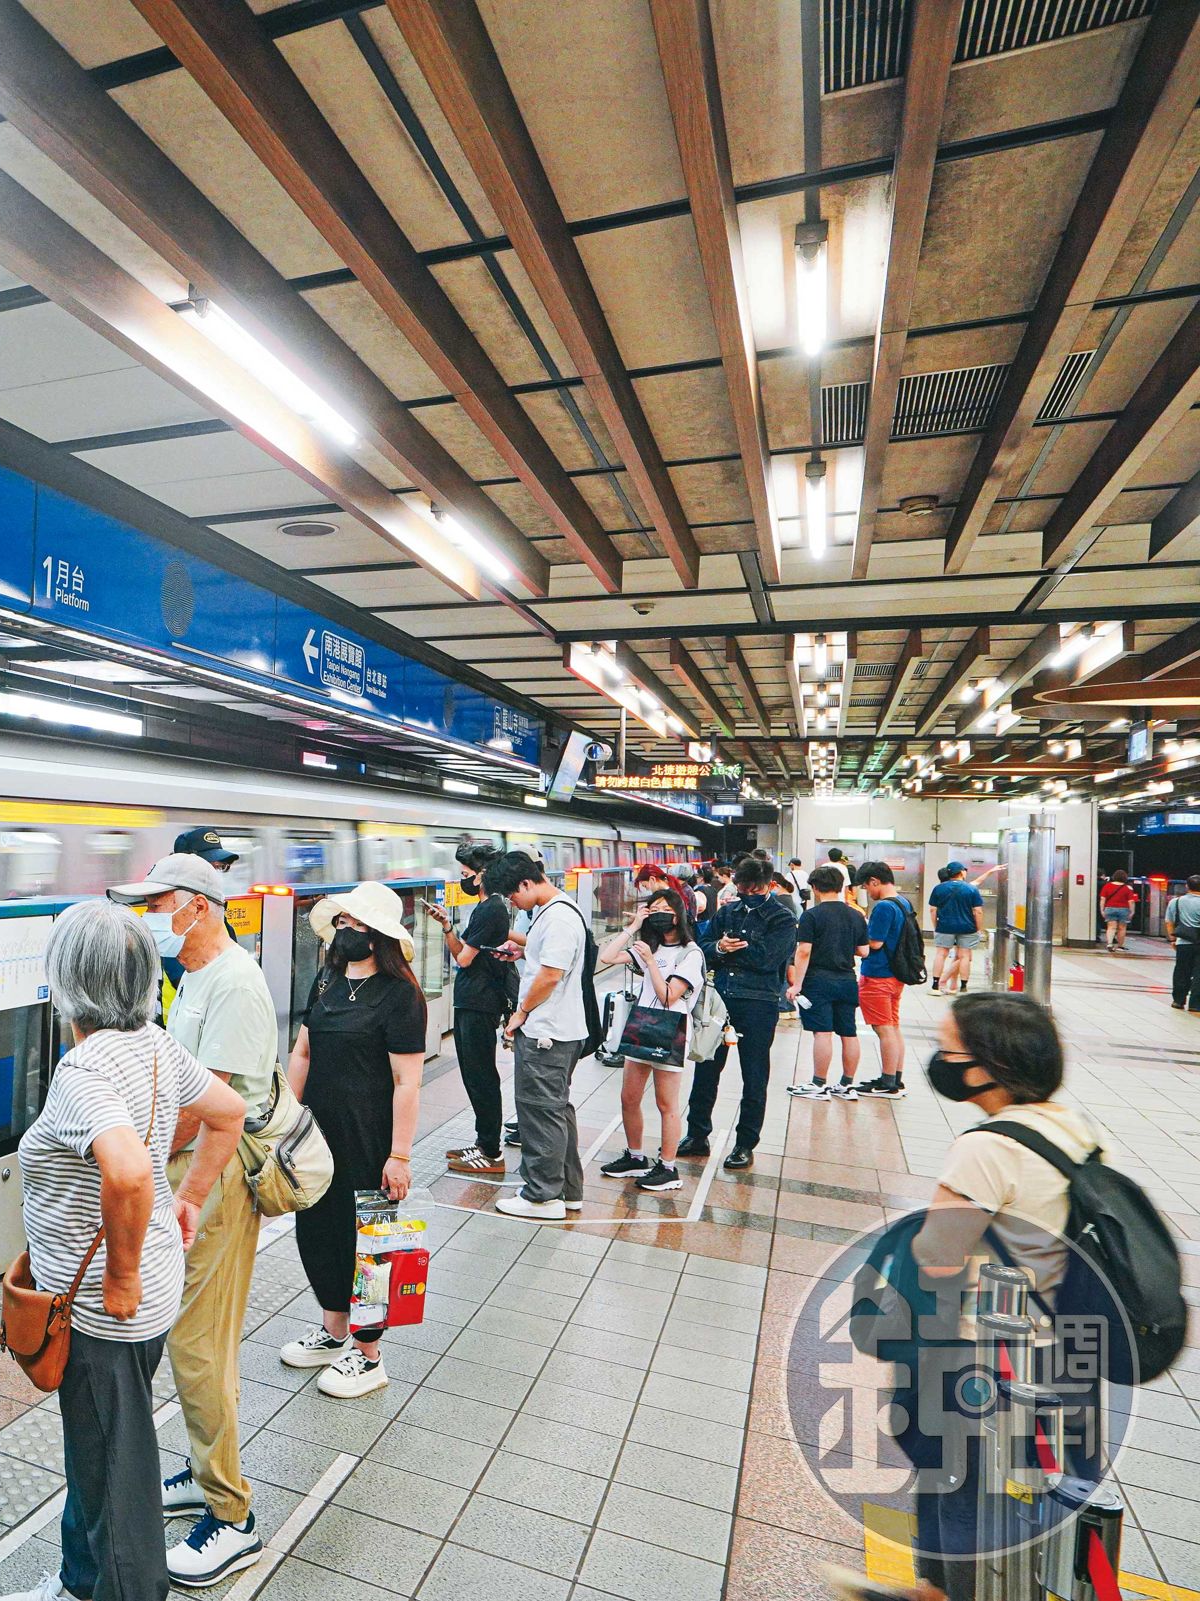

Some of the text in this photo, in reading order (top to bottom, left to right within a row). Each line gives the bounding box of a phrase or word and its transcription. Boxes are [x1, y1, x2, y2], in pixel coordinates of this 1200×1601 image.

[42, 555, 53, 599] 1
[56, 560, 85, 593] 月台
[55, 588, 90, 612] Platform
[323, 671, 362, 694] Exhibition Center
[326, 658, 361, 683] Taipei Nangang
